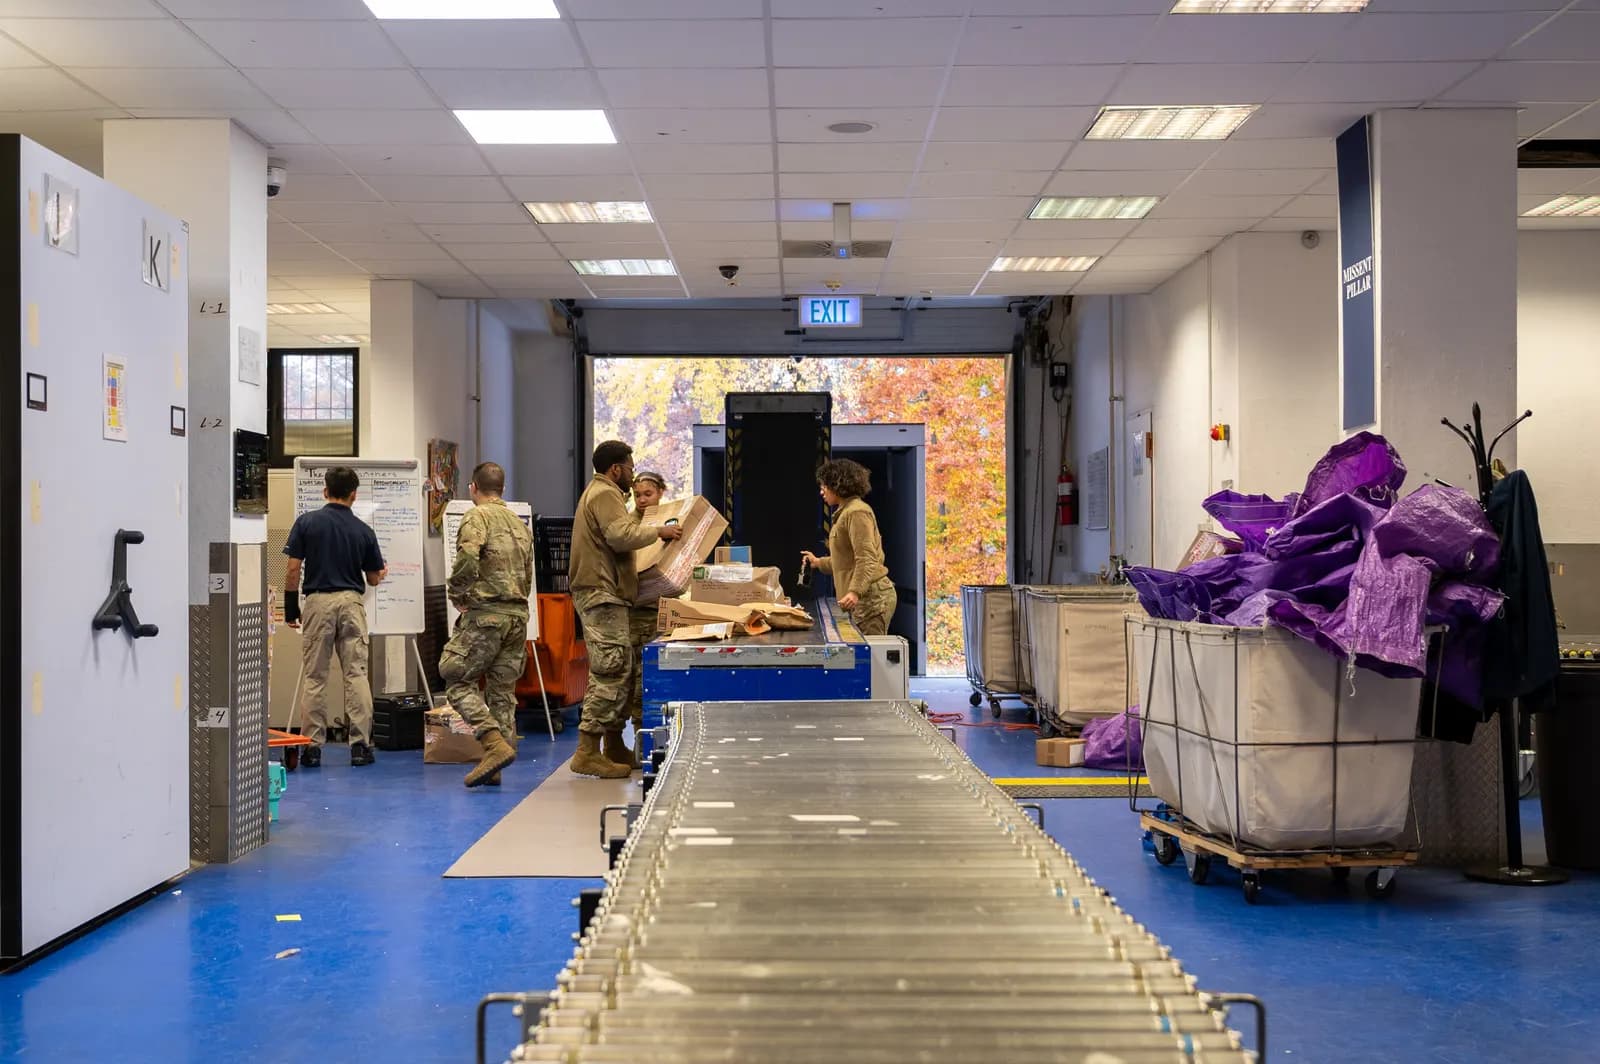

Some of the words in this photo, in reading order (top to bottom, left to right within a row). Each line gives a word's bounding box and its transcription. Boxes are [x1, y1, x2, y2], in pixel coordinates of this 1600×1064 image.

[150, 235, 162, 288] K
[1343, 256, 1372, 284] MISSENT
[1346, 274, 1371, 300] PILLAR
[810, 299, 850, 323] EXIT
